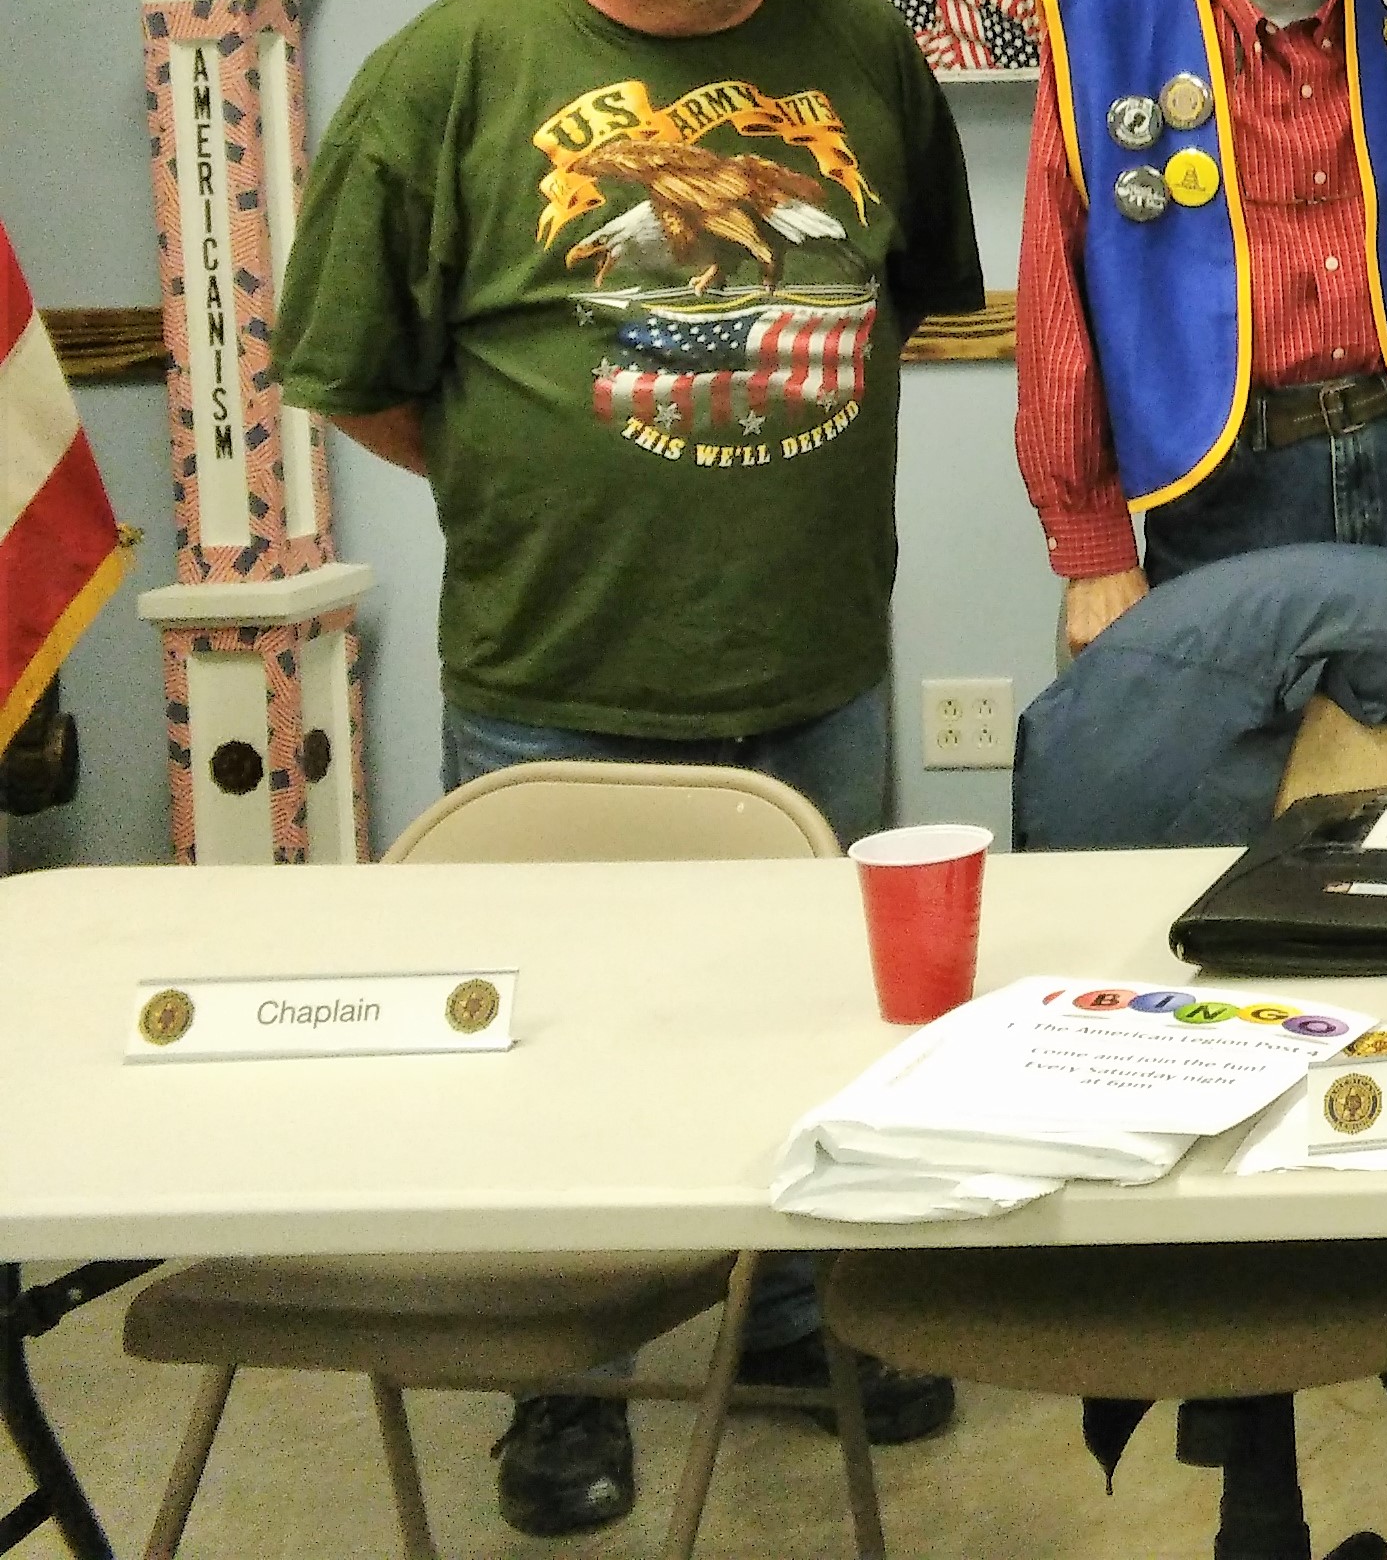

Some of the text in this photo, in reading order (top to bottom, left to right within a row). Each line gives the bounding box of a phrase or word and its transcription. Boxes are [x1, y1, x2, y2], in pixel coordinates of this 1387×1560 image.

[547, 90, 652, 152] U.S.
[675, 84, 763, 140] ARMY
[191, 46, 235, 461] AMERICANISM
[620, 399, 861, 469] THIS WE'LL DEFEND
[256, 997, 382, 1029] Chaplain
[1090, 993, 1338, 1034] BINGO
[1034, 1023, 1069, 1033] The
[1075, 1025, 1174, 1043] American
[1180, 1035, 1250, 1049] Legion
[1254, 1040, 1300, 1055] Post
[1024, 1061, 1237, 1086] Every Saturday night
[1031, 1048, 1267, 1074] Come and join the fun!
[1106, 1080, 1153, 1090] 6pm
